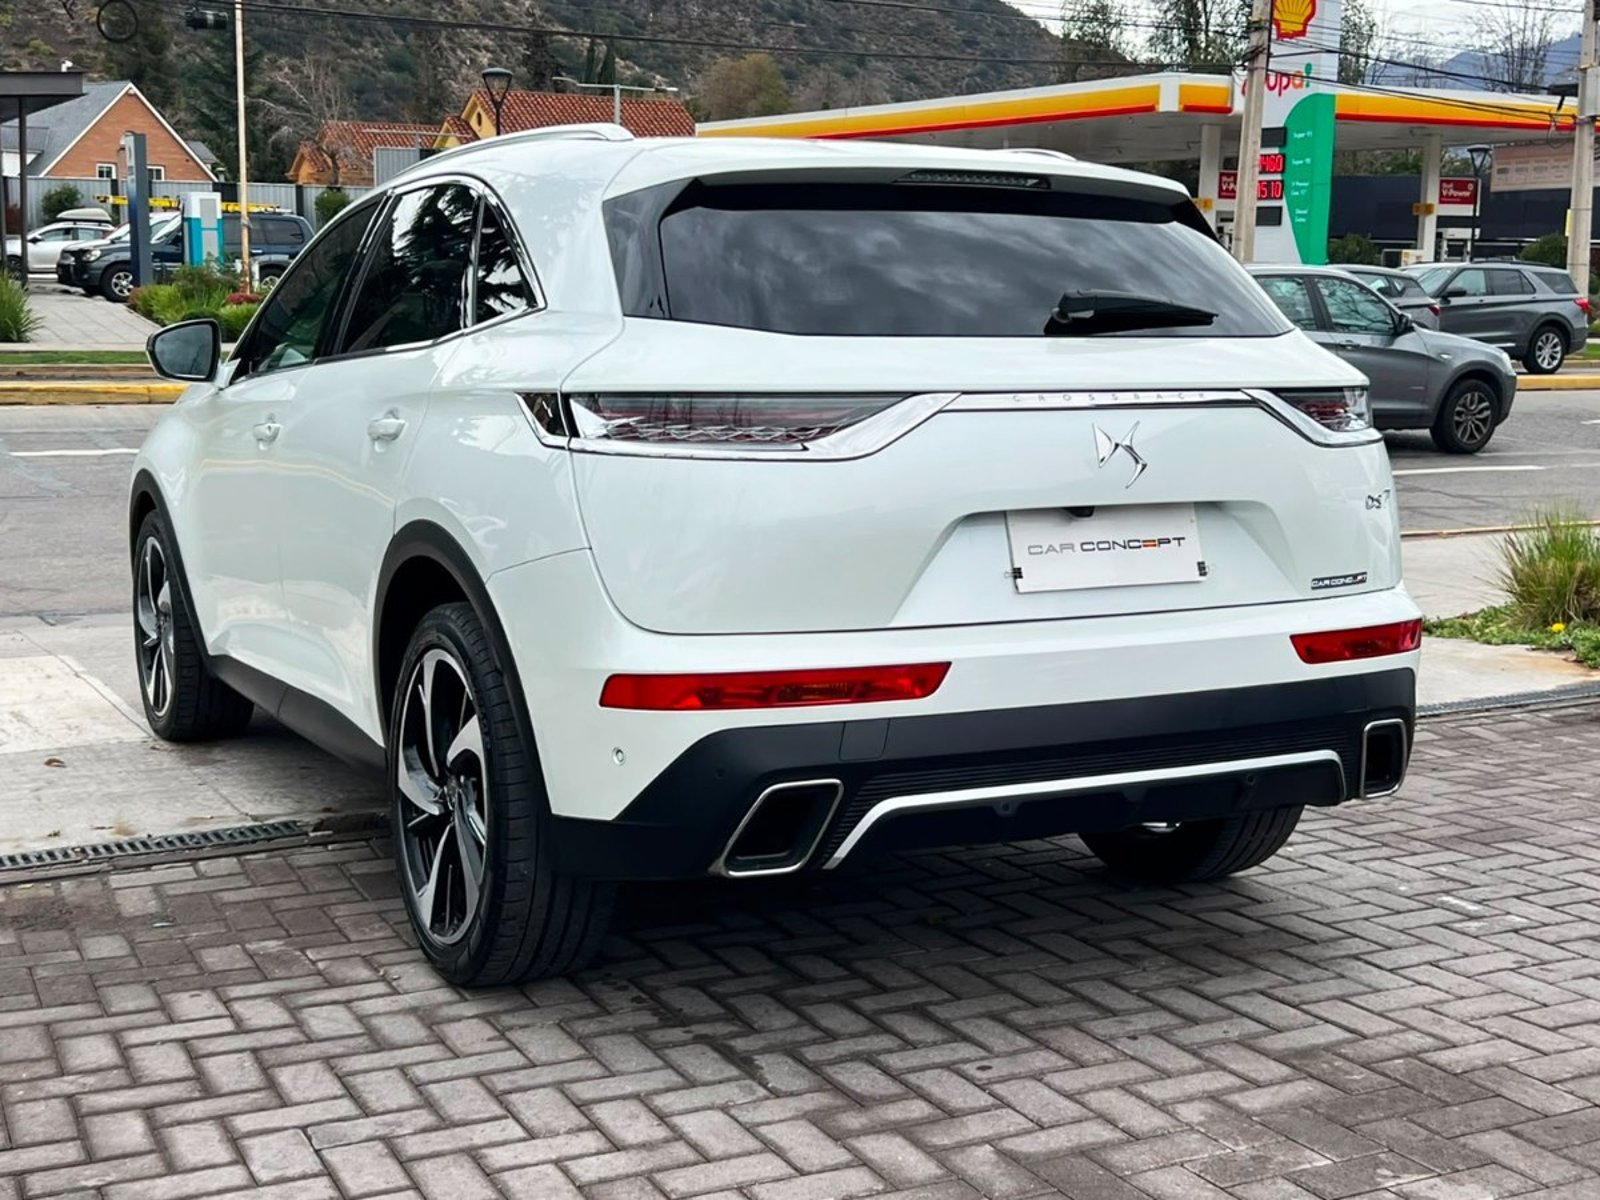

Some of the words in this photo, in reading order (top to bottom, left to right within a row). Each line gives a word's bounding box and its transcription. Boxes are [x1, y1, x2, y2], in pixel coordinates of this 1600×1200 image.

[1256, 180, 1282, 199] 1510
[1027, 543, 1076, 556] CAR
[1080, 536, 1186, 552] CONCEPT
[1311, 579, 1330, 588] CAR
